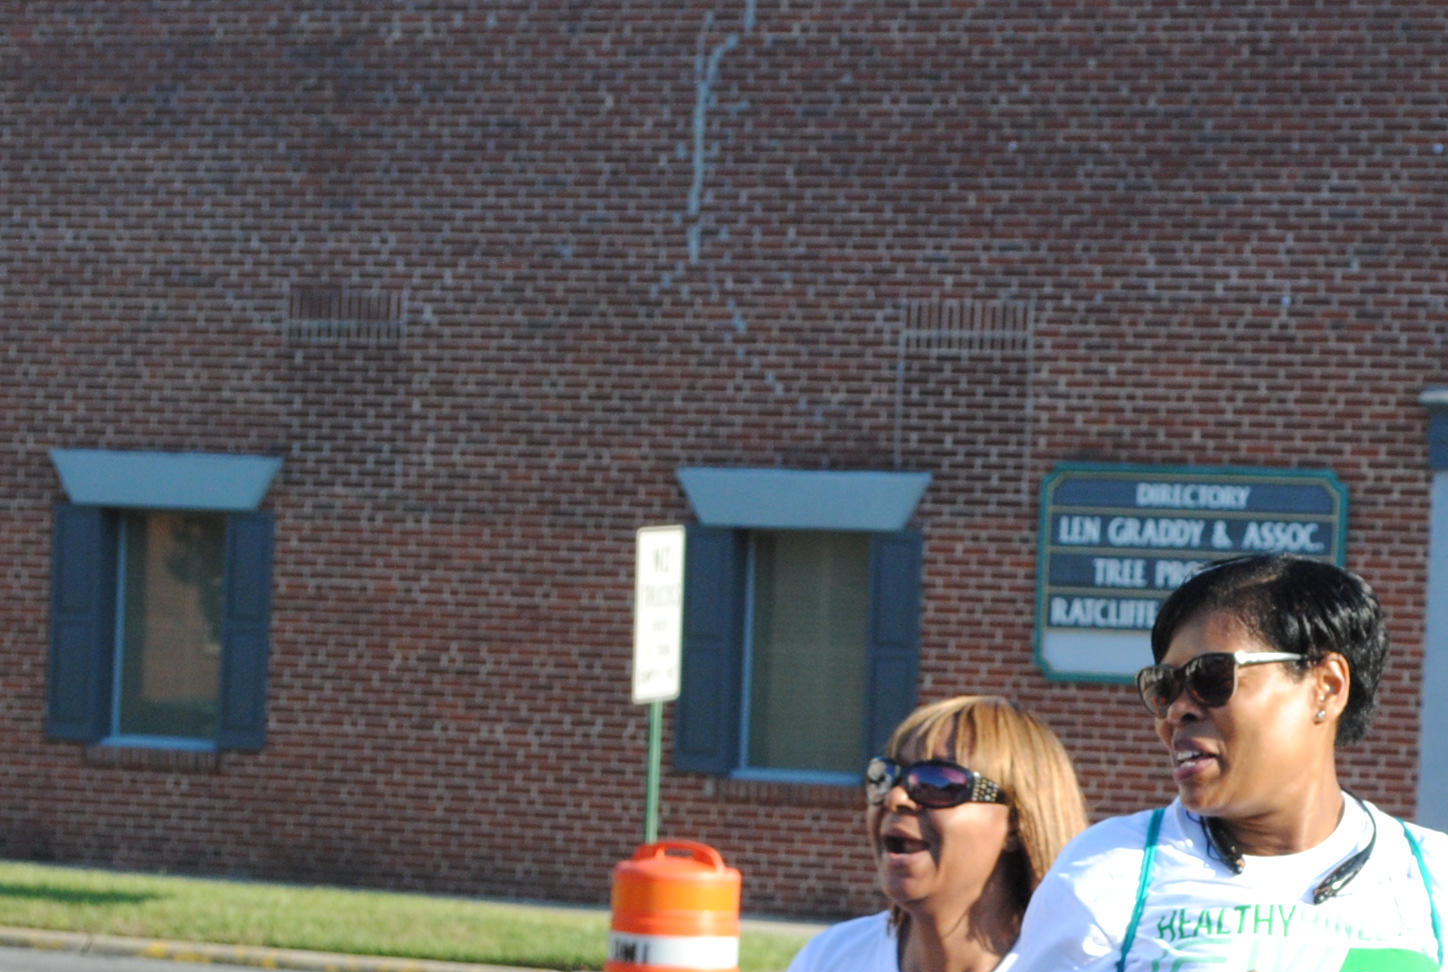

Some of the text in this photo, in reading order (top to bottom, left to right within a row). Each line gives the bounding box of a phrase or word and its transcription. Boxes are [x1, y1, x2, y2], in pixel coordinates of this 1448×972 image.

[1135, 482, 1251, 509] DIRECTORY
[1058, 515, 1325, 552] LEN GRADDY & ASSOC.
[1094, 557, 1148, 588] TREE
[1157, 904, 1297, 941] HEALTHY
